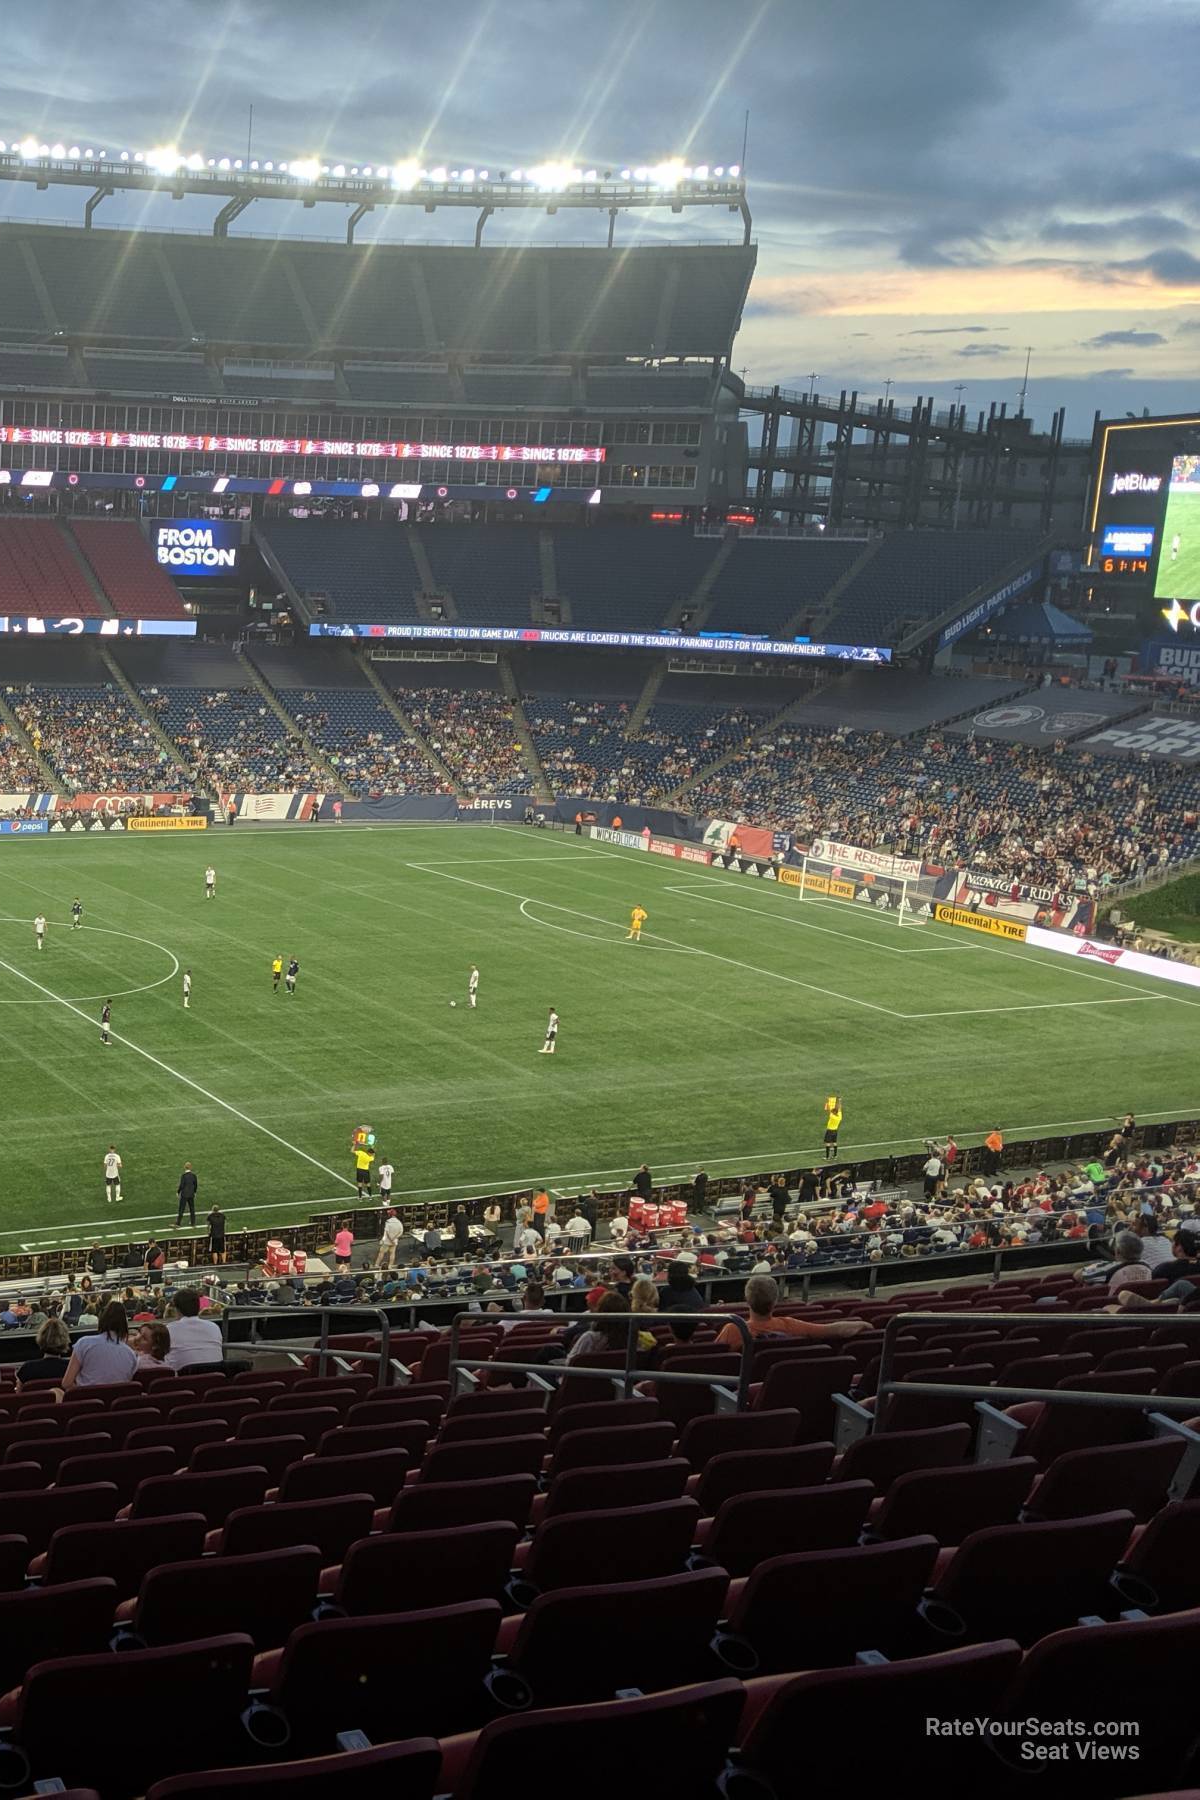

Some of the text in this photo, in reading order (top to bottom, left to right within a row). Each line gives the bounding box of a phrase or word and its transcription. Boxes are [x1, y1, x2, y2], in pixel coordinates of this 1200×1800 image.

[32, 428, 62, 442] SINCE
[130, 434, 160, 448] SINCE
[226, 437, 257, 450] SINCE
[324, 441, 354, 455] SINCE
[422, 445, 453, 458] SINCE
[523, 447, 555, 460] SINCE
[1110, 472, 1161, 494] jetBlue
[158, 528, 213, 547] FROM
[157, 547, 236, 566] BOSTON
[944, 620, 962, 640] BUD
[962, 603, 985, 628] LIGHT
[388, 626, 412, 636] PROUD
[413, 627, 422, 636] TO
[423, 627, 451, 637] SERVICE
[453, 627, 468, 637] YOU
[469, 628, 480, 638] ON
[481, 629, 502, 638] GAME
[503, 630, 520, 639] DAY.
[541, 631, 569, 641] TRUCKS
[570, 632, 585, 641] ARE
[587, 633, 619, 643] LOCATED
[620, 634, 629, 644] IN
[630, 634, 645, 645] THE
[645, 635, 679, 647] STADIUM
[680, 637, 713, 649] PARKING
[715, 638, 734, 650] LOTS
[735, 639, 750, 651] FOR
[751, 640, 772, 651] YOUR
[773, 641, 826, 655] CONVENIENCE
[1136, 717, 1200, 738] TH
[22, 821, 43, 833] pepsi
[130, 817, 205, 830] Continental TIRE
[828, 843, 920, 874] THE REBEION
[781, 870, 853, 895] Contiental TIRE
[966, 873, 1073, 905] MIDNIGT RIDRS
[938, 906, 1024, 938] Continental TIRE
[1080, 944, 1120, 961] Budweiser
